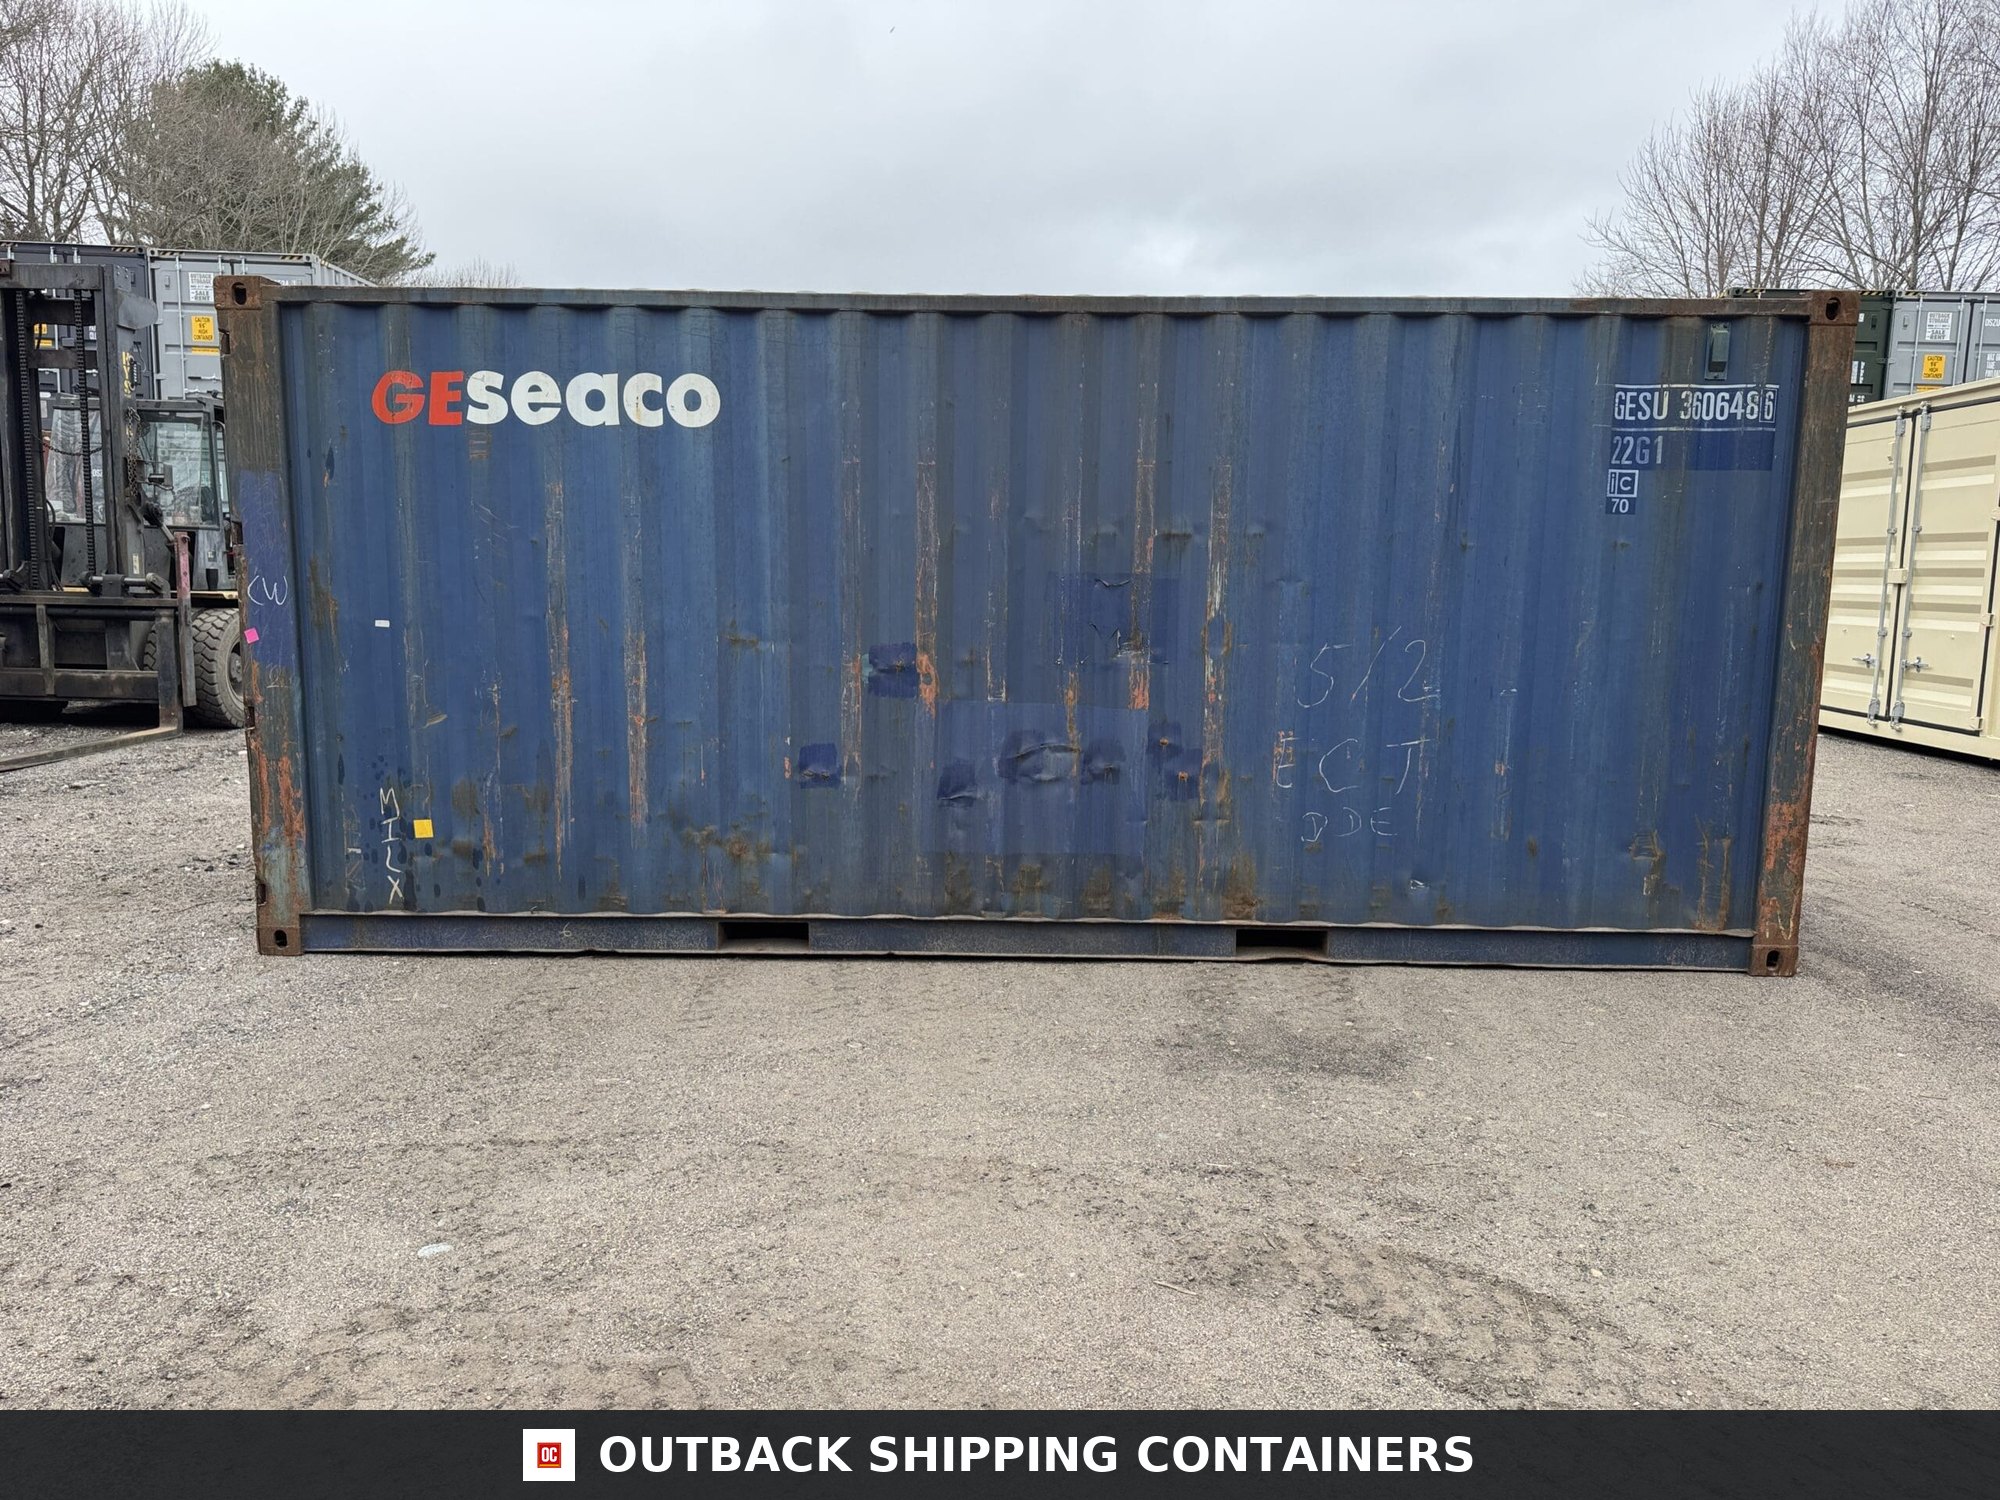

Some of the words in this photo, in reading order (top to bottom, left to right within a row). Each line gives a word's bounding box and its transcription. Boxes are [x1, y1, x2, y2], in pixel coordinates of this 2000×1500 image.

[1614, 391, 1669, 421] GESU
[1611, 435, 1664, 465] 22G1
[1611, 499, 1629, 514] 70
